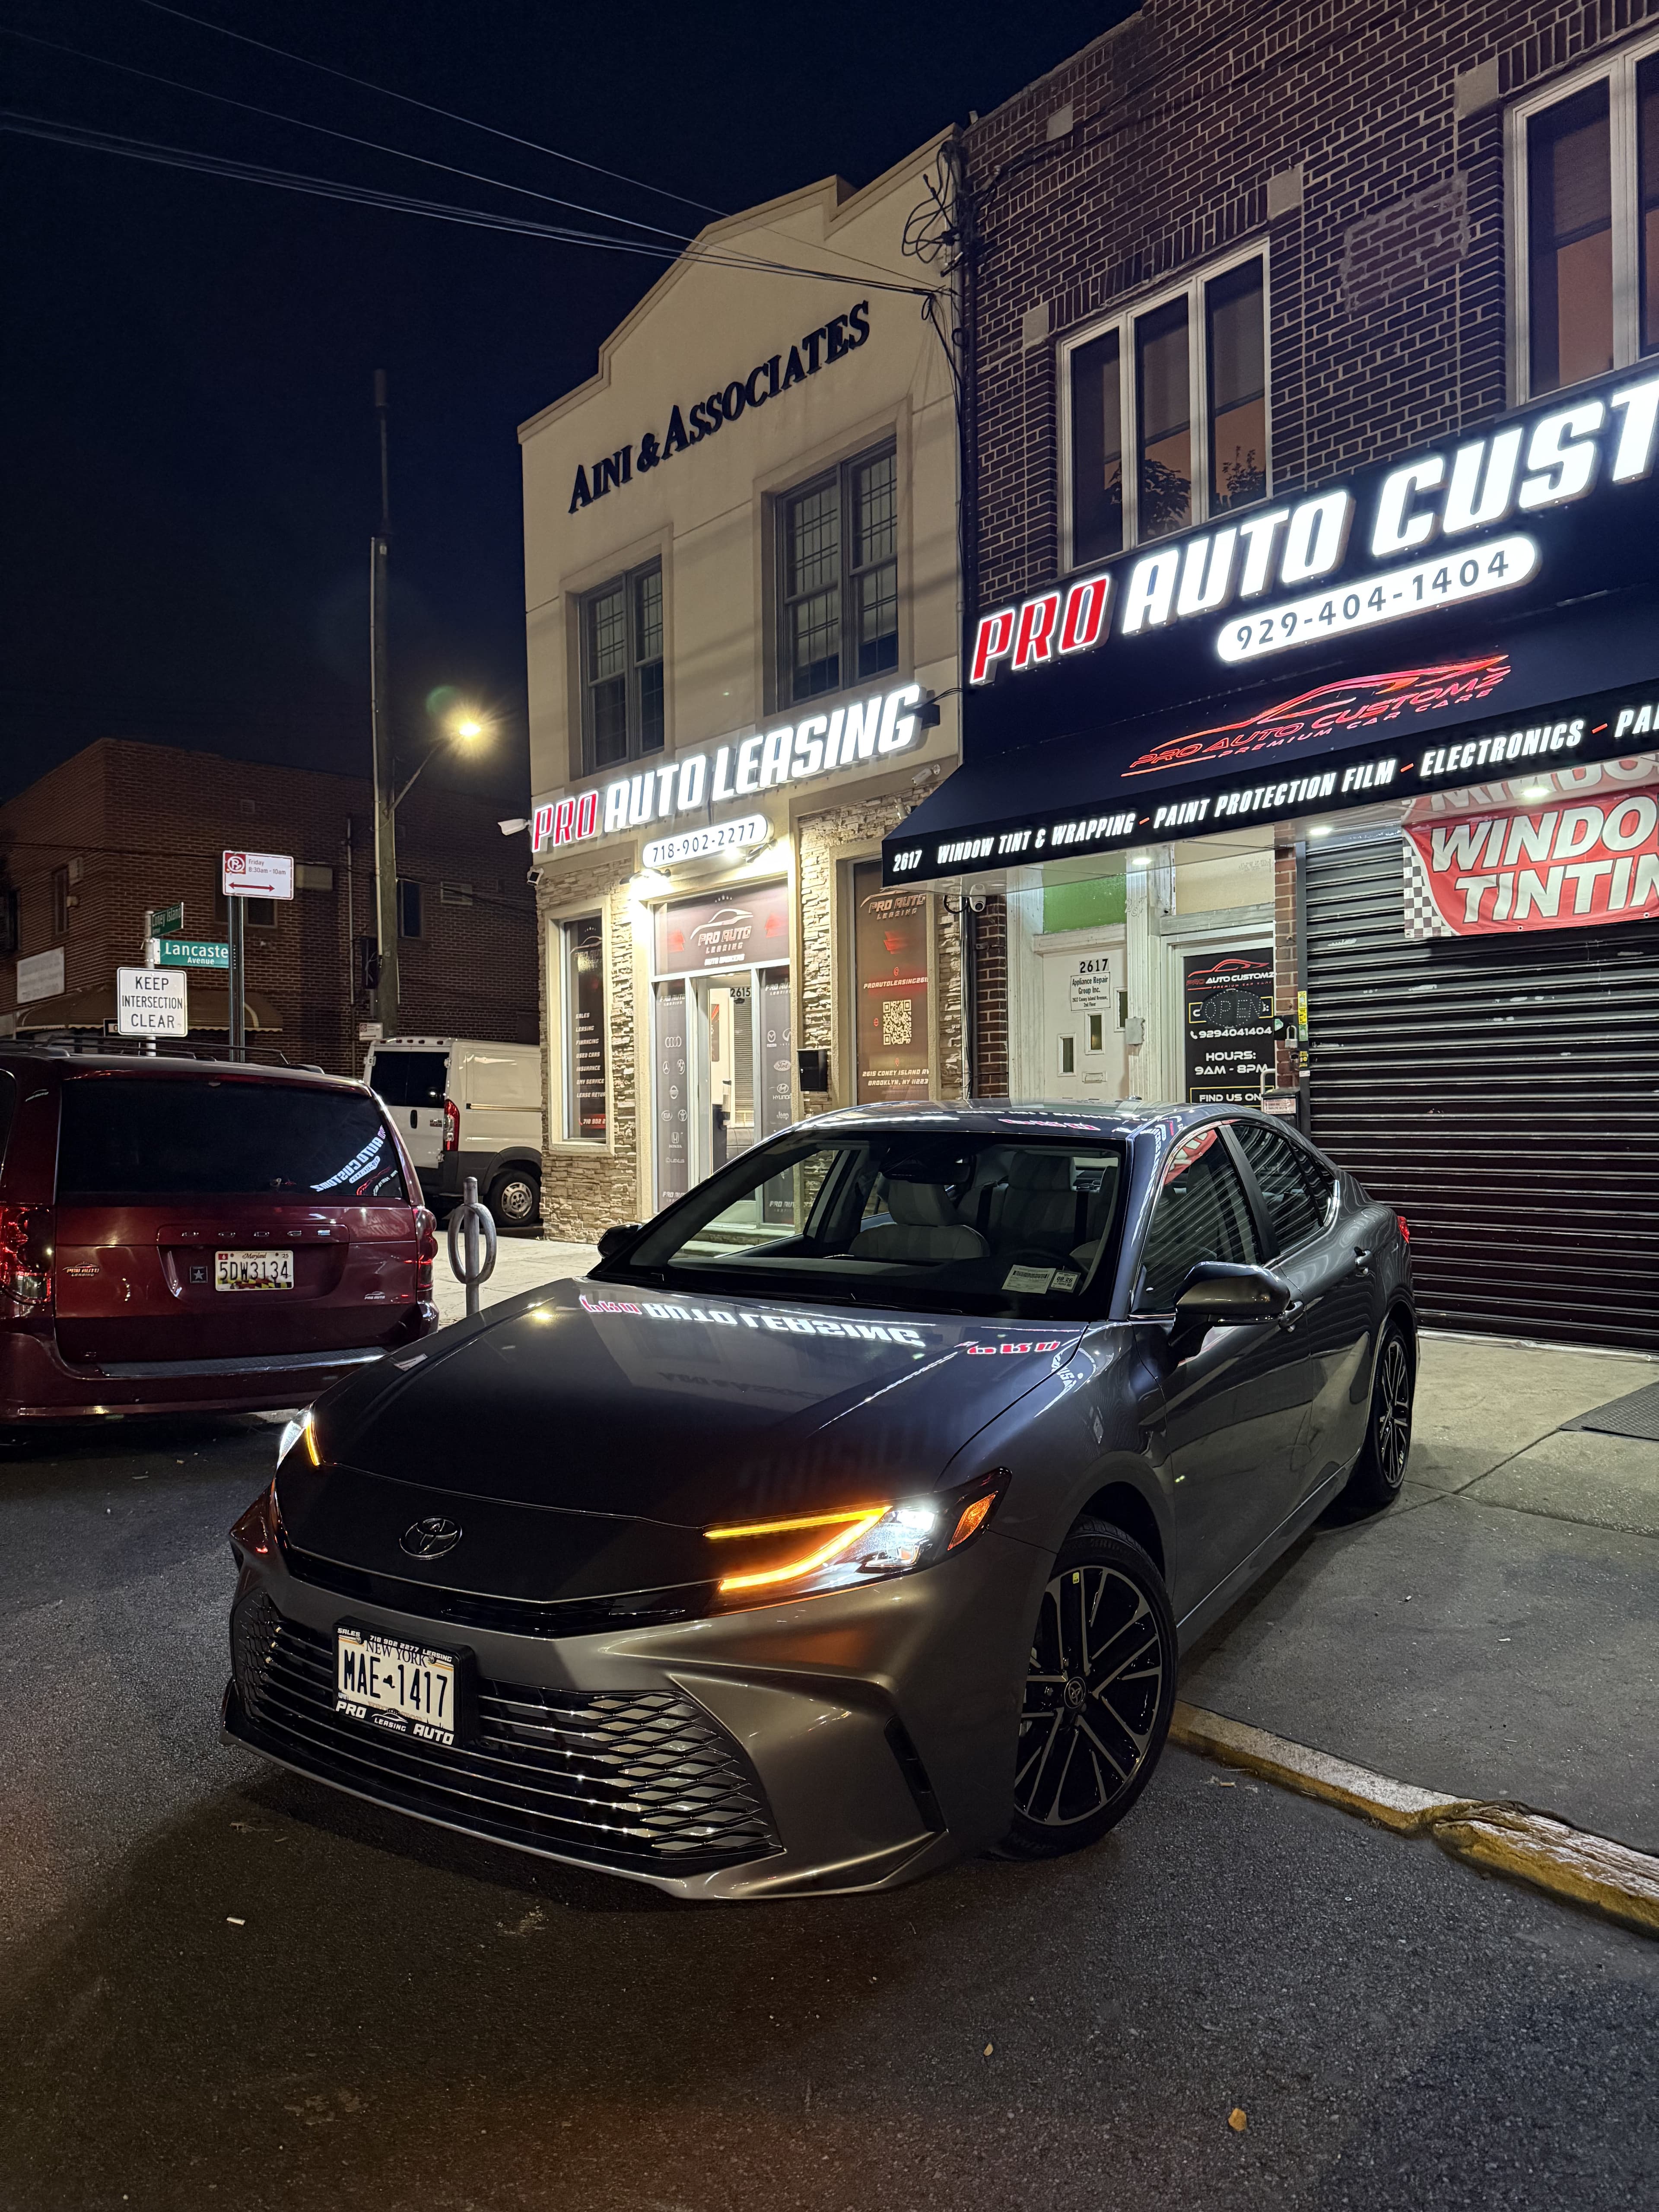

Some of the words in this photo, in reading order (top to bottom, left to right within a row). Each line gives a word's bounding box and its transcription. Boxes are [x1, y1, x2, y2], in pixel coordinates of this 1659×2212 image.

[568, 445, 632, 514] AINI
[636, 433, 660, 473] &
[661, 300, 870, 460] ASSOCIATES
[970, 574, 1110, 685] PRO
[1122, 491, 1348, 634] AUTO
[1236, 550, 1509, 650] 929-404-1404
[1129, 744, 1203, 768] PRO
[1202, 722, 1305, 753] AUTO
[1311, 666, 1510, 729] CUSTOMZ
[1218, 728, 1332, 758] PREMIUM
[1347, 711, 1401, 729] CAR
[1415, 688, 1494, 712] CARE
[532, 789, 599, 852] PRO
[604, 755, 707, 833] AUTO
[712, 684, 921, 801] LEASING
[893, 850, 922, 872] 2617
[937, 837, 994, 863] WINDOW
[998, 831, 1031, 854] TINT
[1035, 829, 1044, 848] &
[1052, 813, 1136, 845] WRAPPING
[1154, 798, 1210, 829] PAINT
[1215, 772, 1337, 817] PROTECTION
[1342, 760, 1395, 792] FILM
[1420, 720, 1585, 777] ELECTRONICS
[653, 823, 754, 862] 718-902-2277
[1432, 795, 1659, 873] WINDO
[868, 899, 893, 913] PRO
[894, 893, 927, 909] AUTO
[877, 908, 917, 919] LEASING
[698, 931, 721, 946] PRO
[721, 926, 752, 942] AUTO
[166, 943, 228, 958] Lancaste
[706, 942, 743, 954] LEASING
[1080, 959, 1108, 973] 2617
[135, 976, 168, 990] KEEP
[1072, 978, 1092, 987] Appliance
[1093, 976, 1108, 985] Repair
[1205, 976, 1230, 984] AUTO
[1231, 972, 1274, 982] CUSTOMZ
[122, 995, 182, 1009] INTERSECTION
[731, 988, 750, 997] 2615
[1205, 999, 1261, 1018] OPEN
[131, 1014, 174, 1028] CLEAR
[1198, 1027, 1272, 1039] 9294041404
[1206, 1051, 1256, 1061] HOURS:
[1195, 1065, 1226, 1075] 9AM
[1237, 1063, 1268, 1074] 8PM
[1226, 1093, 1242, 1102] US
[776, 1111, 789, 1120] Jeep
[220, 1261, 289, 1281] 5DW3134
[337, 1627, 360, 1637] SALES
[383, 1638, 398, 1647] 902
[400, 1643, 419, 1652] 2277
[423, 1649, 452, 1662] LEASING
[366, 1641, 393, 1658] NEW
[396, 1647, 427, 1668] YORK
[344, 1649, 381, 1699] MAE
[397, 1664, 448, 1717] 1417
[336, 1700, 367, 1719] PRO
[374, 1717, 406, 1732] LEASING
[413, 1723, 454, 1745] AUTO
